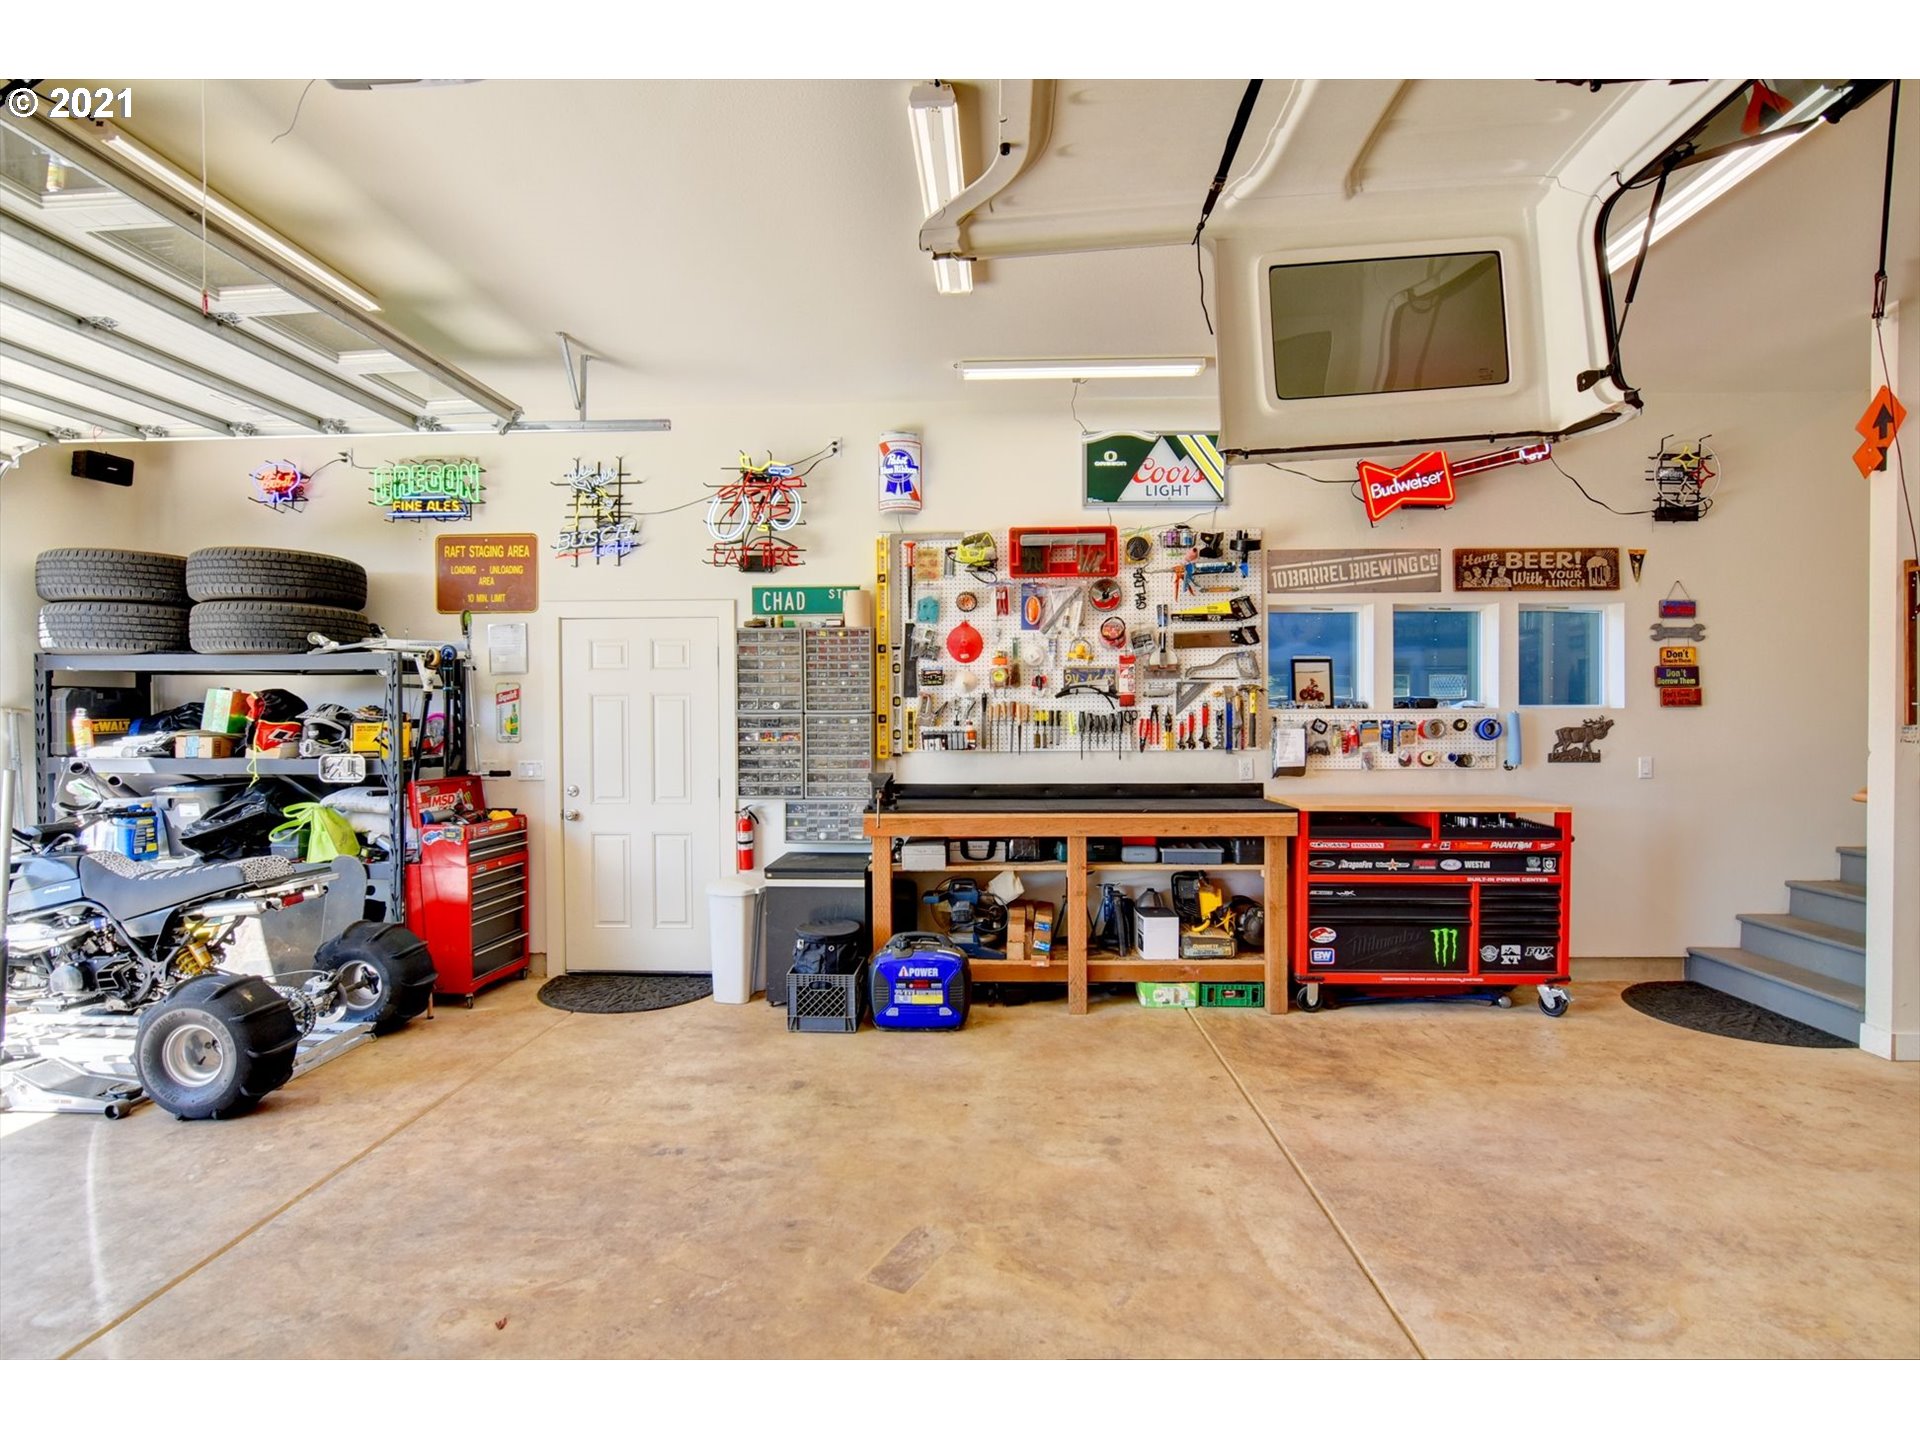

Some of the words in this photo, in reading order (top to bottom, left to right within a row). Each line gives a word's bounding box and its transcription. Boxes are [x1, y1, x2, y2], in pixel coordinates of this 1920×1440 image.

[1132, 457, 1206, 484] Coors
[374, 463, 480, 505] OREGON
[1370, 470, 1445, 499] Budweiser
[1146, 485, 1191, 496] LIGHT
[392, 500, 423, 511] FINE
[426, 500, 460, 511] ALES
[556, 522, 635, 552] BUSCH
[444, 545, 466, 558] RAFT
[469, 545, 504, 558] STAGING
[507, 545, 530, 558] AREA
[593, 542, 634, 557] LIGHT
[1462, 552, 1499, 567] Have
[1488, 560, 1499, 569] a
[1505, 551, 1582, 569] BEER!
[450, 565, 477, 575] LOADING
[489, 565, 524, 575] UNLOADING
[1349, 555, 1418, 580] BREWING
[478, 577, 495, 586] AREA
[1512, 570, 1545, 586] With
[1549, 570, 1583, 579] YOUR
[1545, 579, 1586, 588] LUNCH
[468, 593, 475, 603] 10
[491, 593, 506, 603] LIMIT
[762, 591, 806, 611] CHAD
[828, 588, 843, 599] ST
[1666, 649, 1689, 659] Don't
[1666, 668, 1687, 677] Don't
[1680, 677, 1696, 685] Them
[432, 794, 454, 806] MSD
